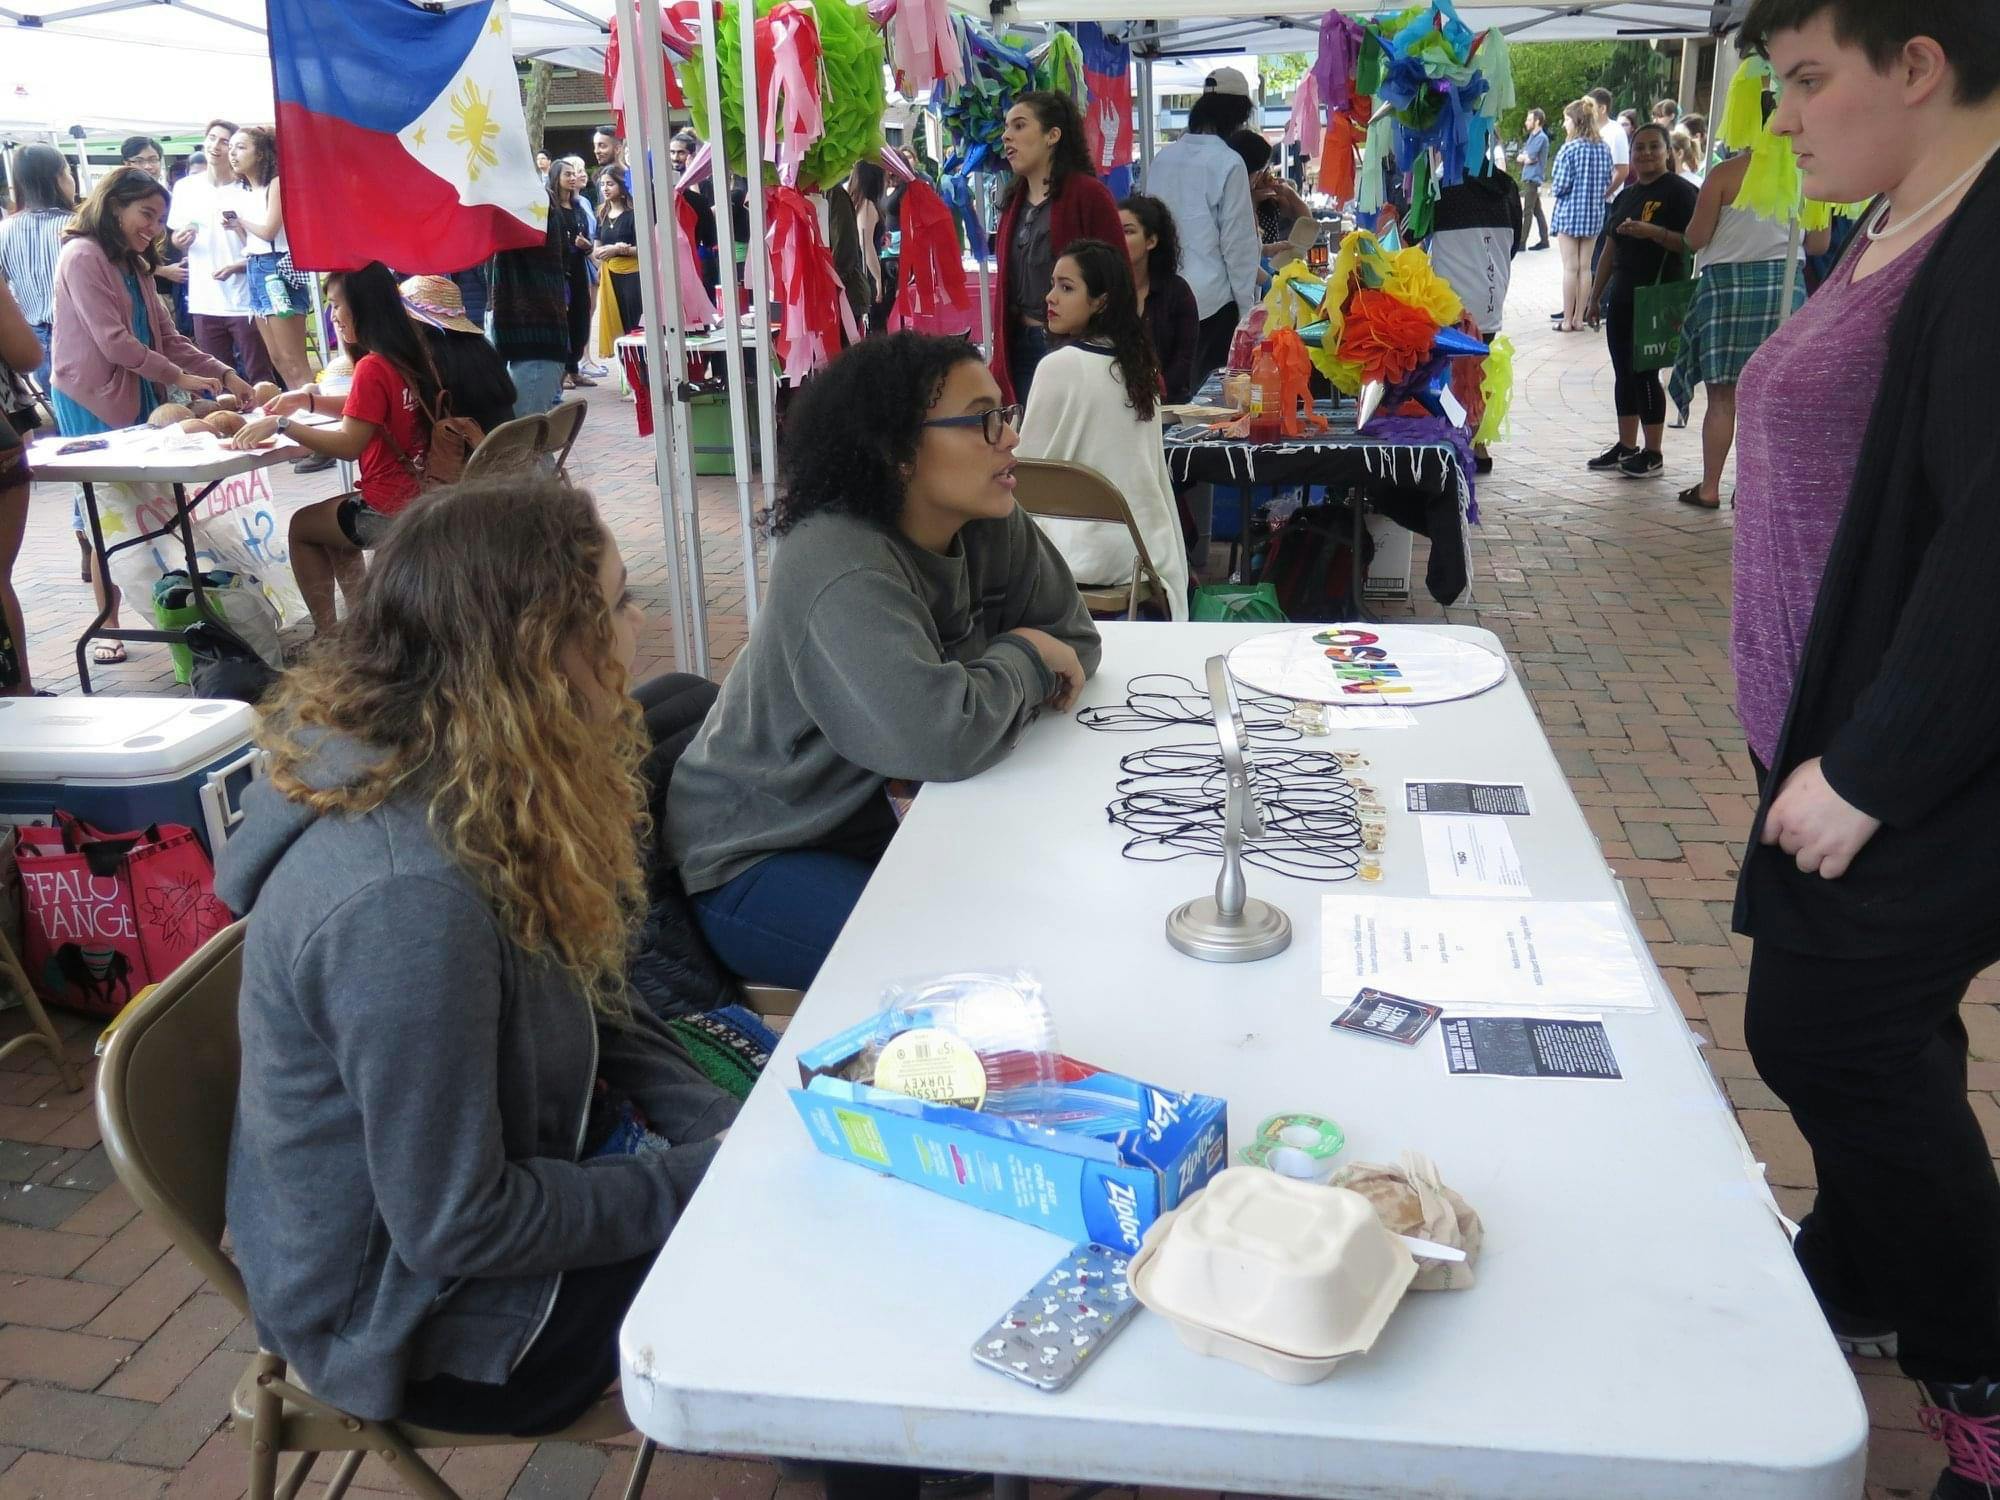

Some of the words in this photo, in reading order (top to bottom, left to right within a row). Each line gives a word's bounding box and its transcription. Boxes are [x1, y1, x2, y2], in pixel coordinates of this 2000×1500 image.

[1643, 341, 1666, 356] my
[1312, 628, 1413, 695] MISO
[1368, 1003, 1394, 1023] NIGHT
[1377, 1007, 1410, 1032] MARKET
[904, 1075, 953, 1089] TURKEY
[904, 1087, 955, 1099] CLASSIC
[1178, 1125, 1215, 1197] Ziploc
[1034, 1163, 1046, 1190] OPEN
[1046, 1180, 1057, 1206] EASY
[1107, 1179, 1141, 1250] Ziploc
